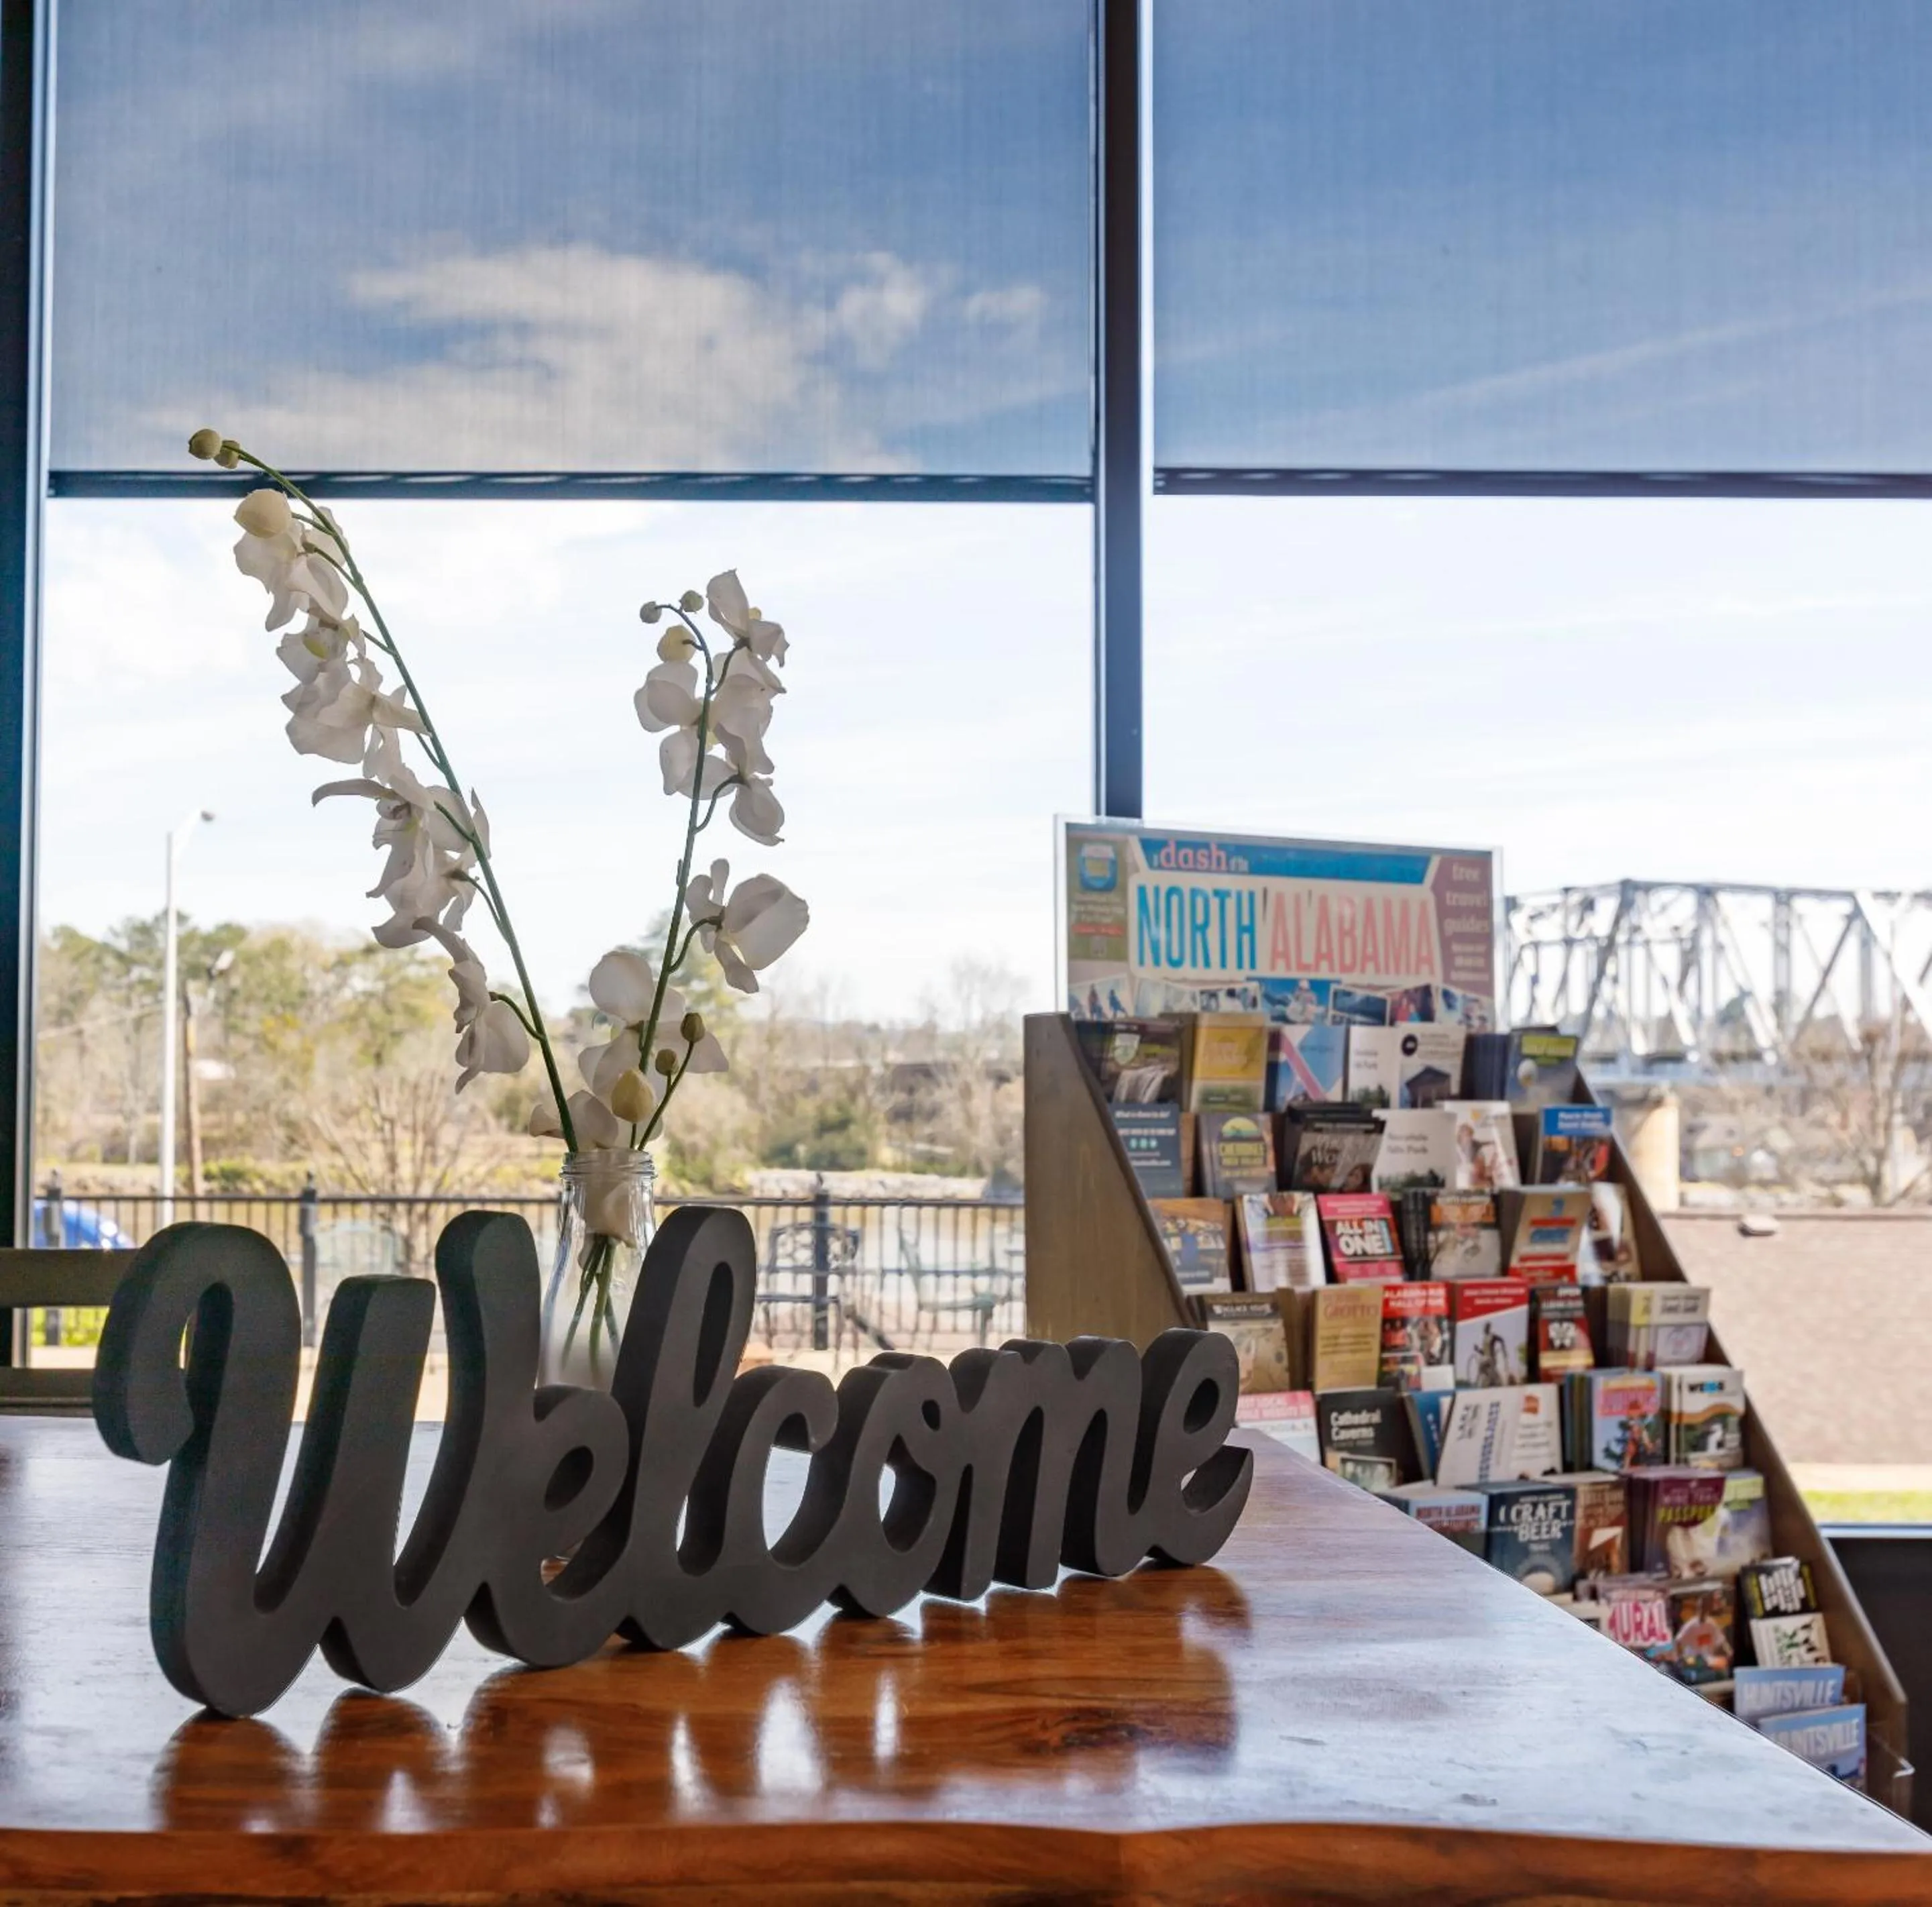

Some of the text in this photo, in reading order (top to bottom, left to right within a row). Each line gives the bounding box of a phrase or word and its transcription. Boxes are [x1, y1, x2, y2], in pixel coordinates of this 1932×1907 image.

[1160, 839, 1226, 871] dash
[1137, 884, 1257, 970] NORTH
[1269, 891, 1436, 976] ALABAMA
[1336, 1219, 1380, 1236] ALL IN
[1339, 1234, 1384, 1256] ONE
[1330, 1410, 1382, 1427] Cathedral
[1331, 1426, 1374, 1441] Caverns
[93, 1205, 1253, 1718] Welcome
[1510, 1500, 1571, 1525] CRAFT
[1518, 1518, 1563, 1542] BEER
[1742, 1679, 1837, 1710] HUNTSVILLE
